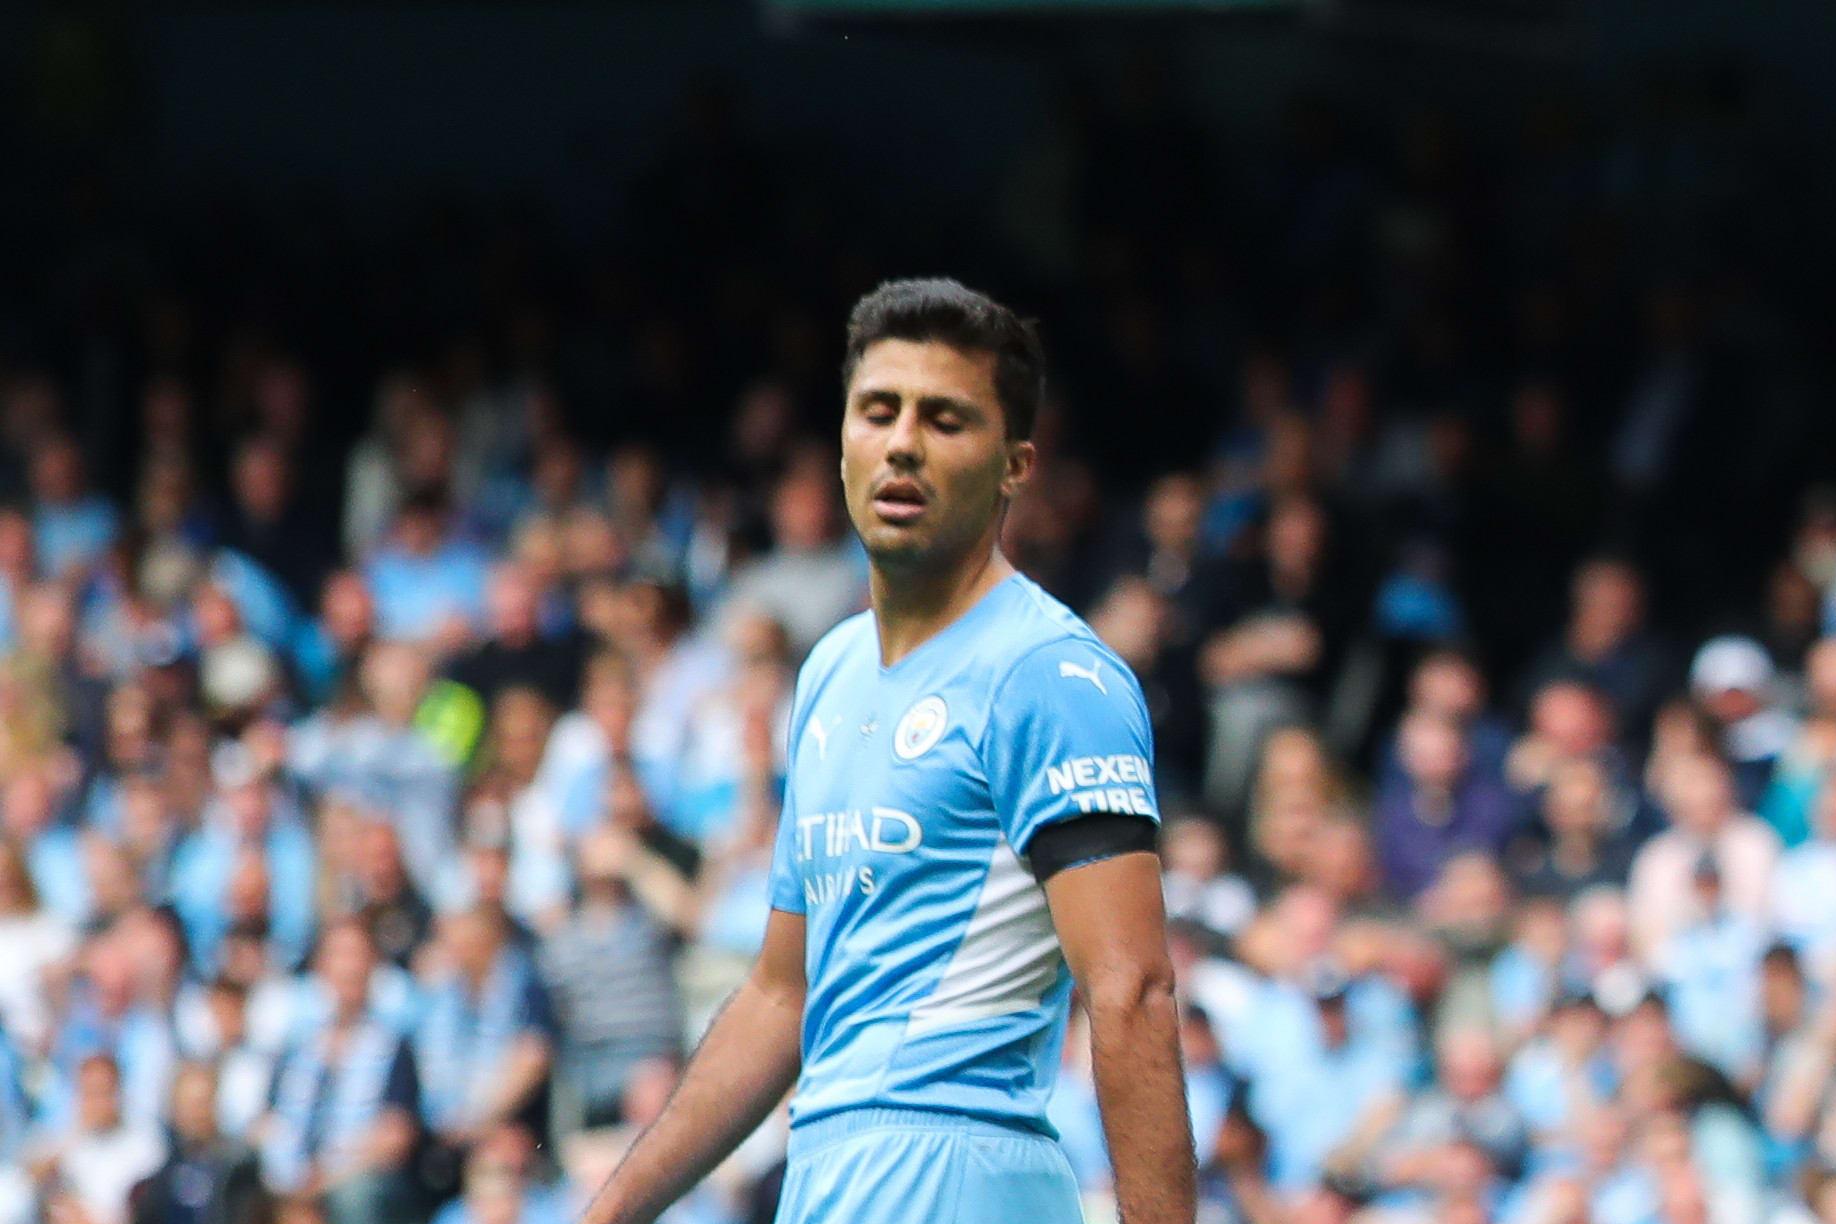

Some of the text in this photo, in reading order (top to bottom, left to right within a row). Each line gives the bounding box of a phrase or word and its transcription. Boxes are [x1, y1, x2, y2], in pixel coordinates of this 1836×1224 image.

[1046, 753, 1152, 796] NEXEN
[1070, 787, 1154, 816] TIRE
[797, 806, 923, 860] TIHAD
